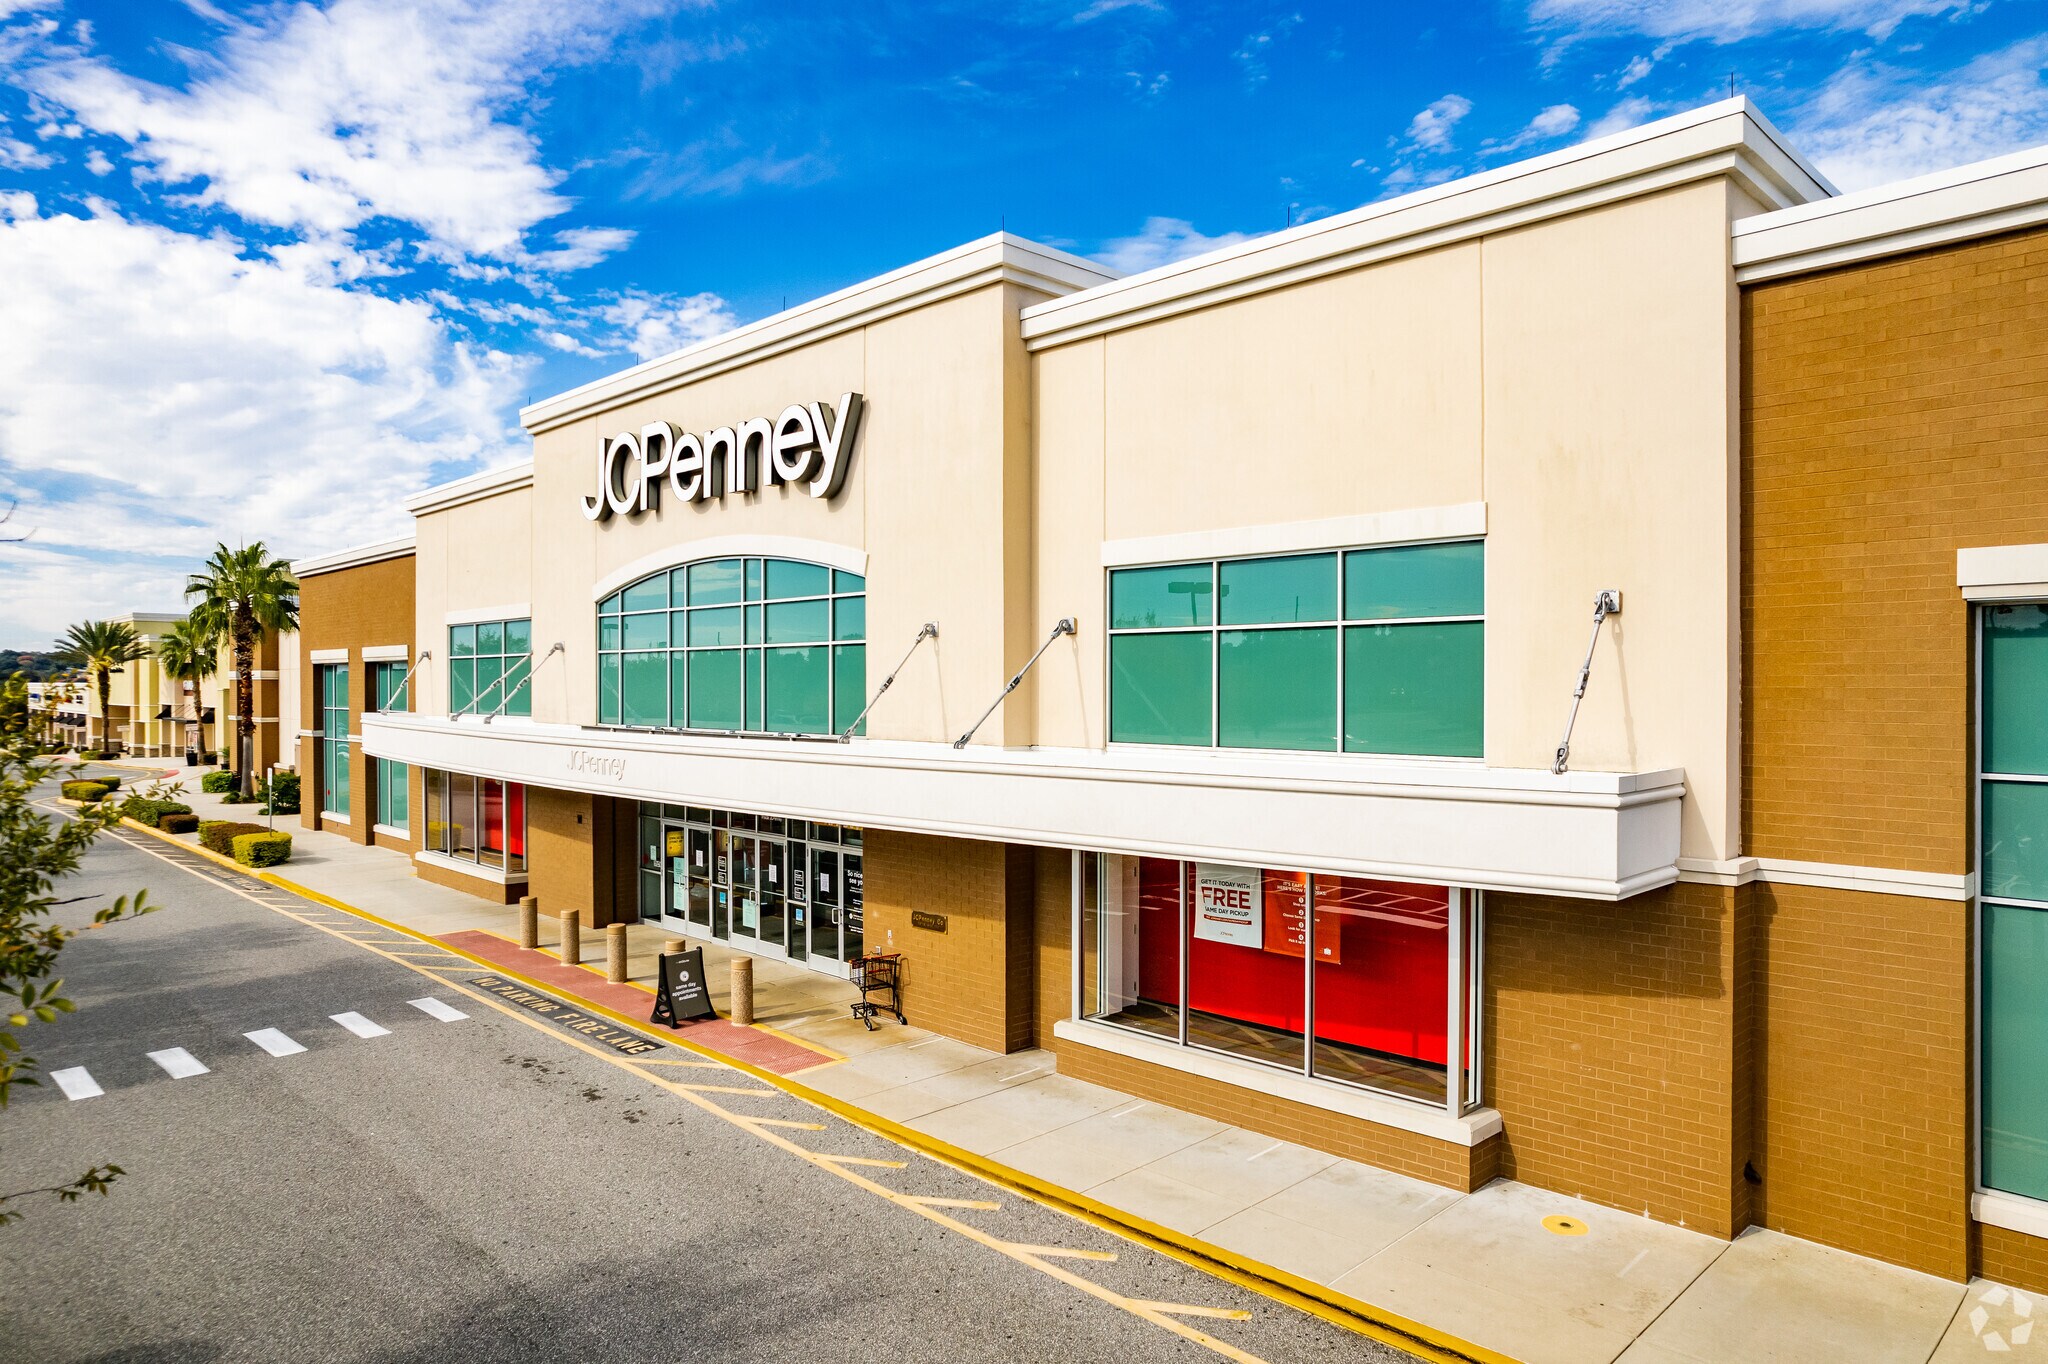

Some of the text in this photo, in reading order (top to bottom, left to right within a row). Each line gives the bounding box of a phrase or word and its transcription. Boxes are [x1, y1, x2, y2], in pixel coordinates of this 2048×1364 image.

[580, 391, 863, 521] JCPenney
[567, 750, 626, 781] JCPenney
[1201, 886, 1251, 910] FREE
[1236, 882, 1251, 890] WITH
[1229, 909, 1250, 917] PICKUP
[472, 977, 656, 1054] NO PARKING FIRE LANE
